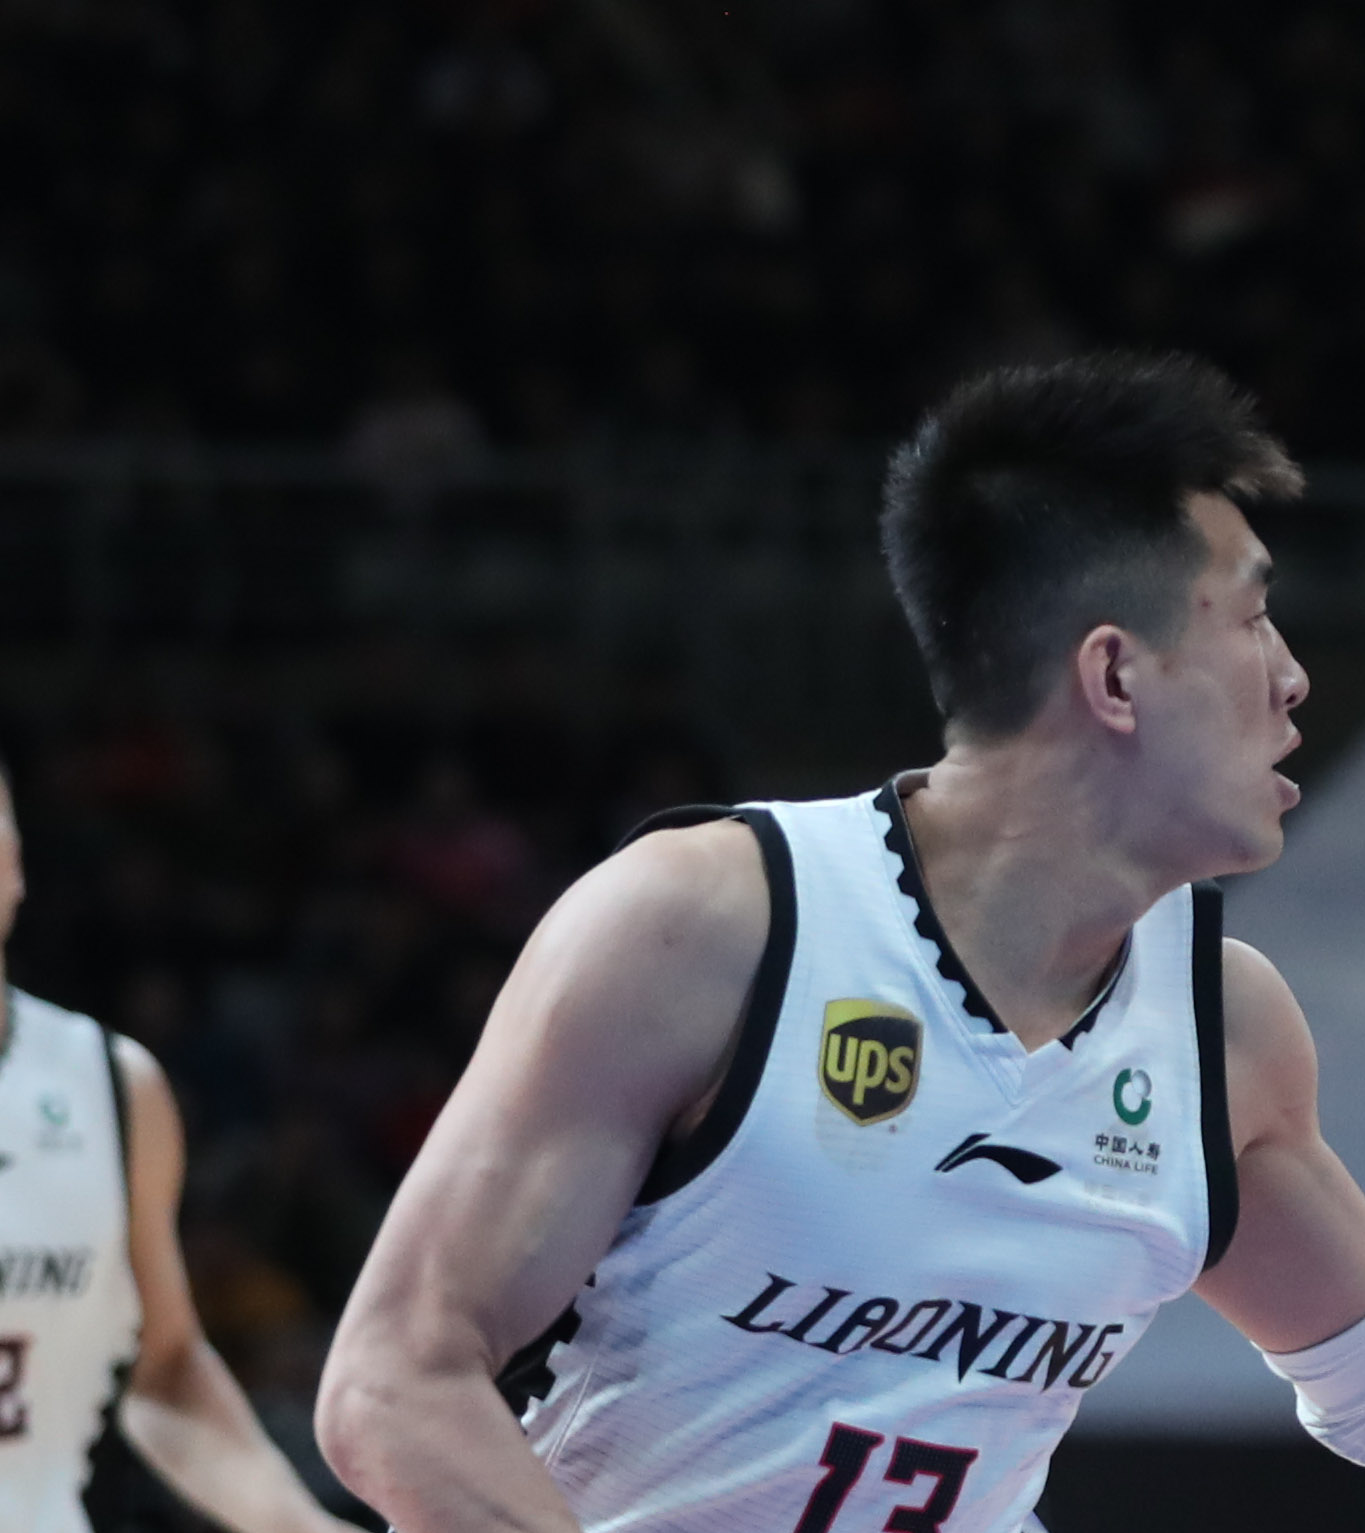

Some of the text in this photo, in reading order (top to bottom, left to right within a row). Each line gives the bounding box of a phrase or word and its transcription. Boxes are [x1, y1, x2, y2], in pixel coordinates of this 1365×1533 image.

[826, 1033, 914, 1106] ups
[1094, 1133, 1160, 1161] 中国人寿
[1094, 1154, 1158, 1175] CHINA LIFE
[720, 1272, 1124, 1393] LIAONING
